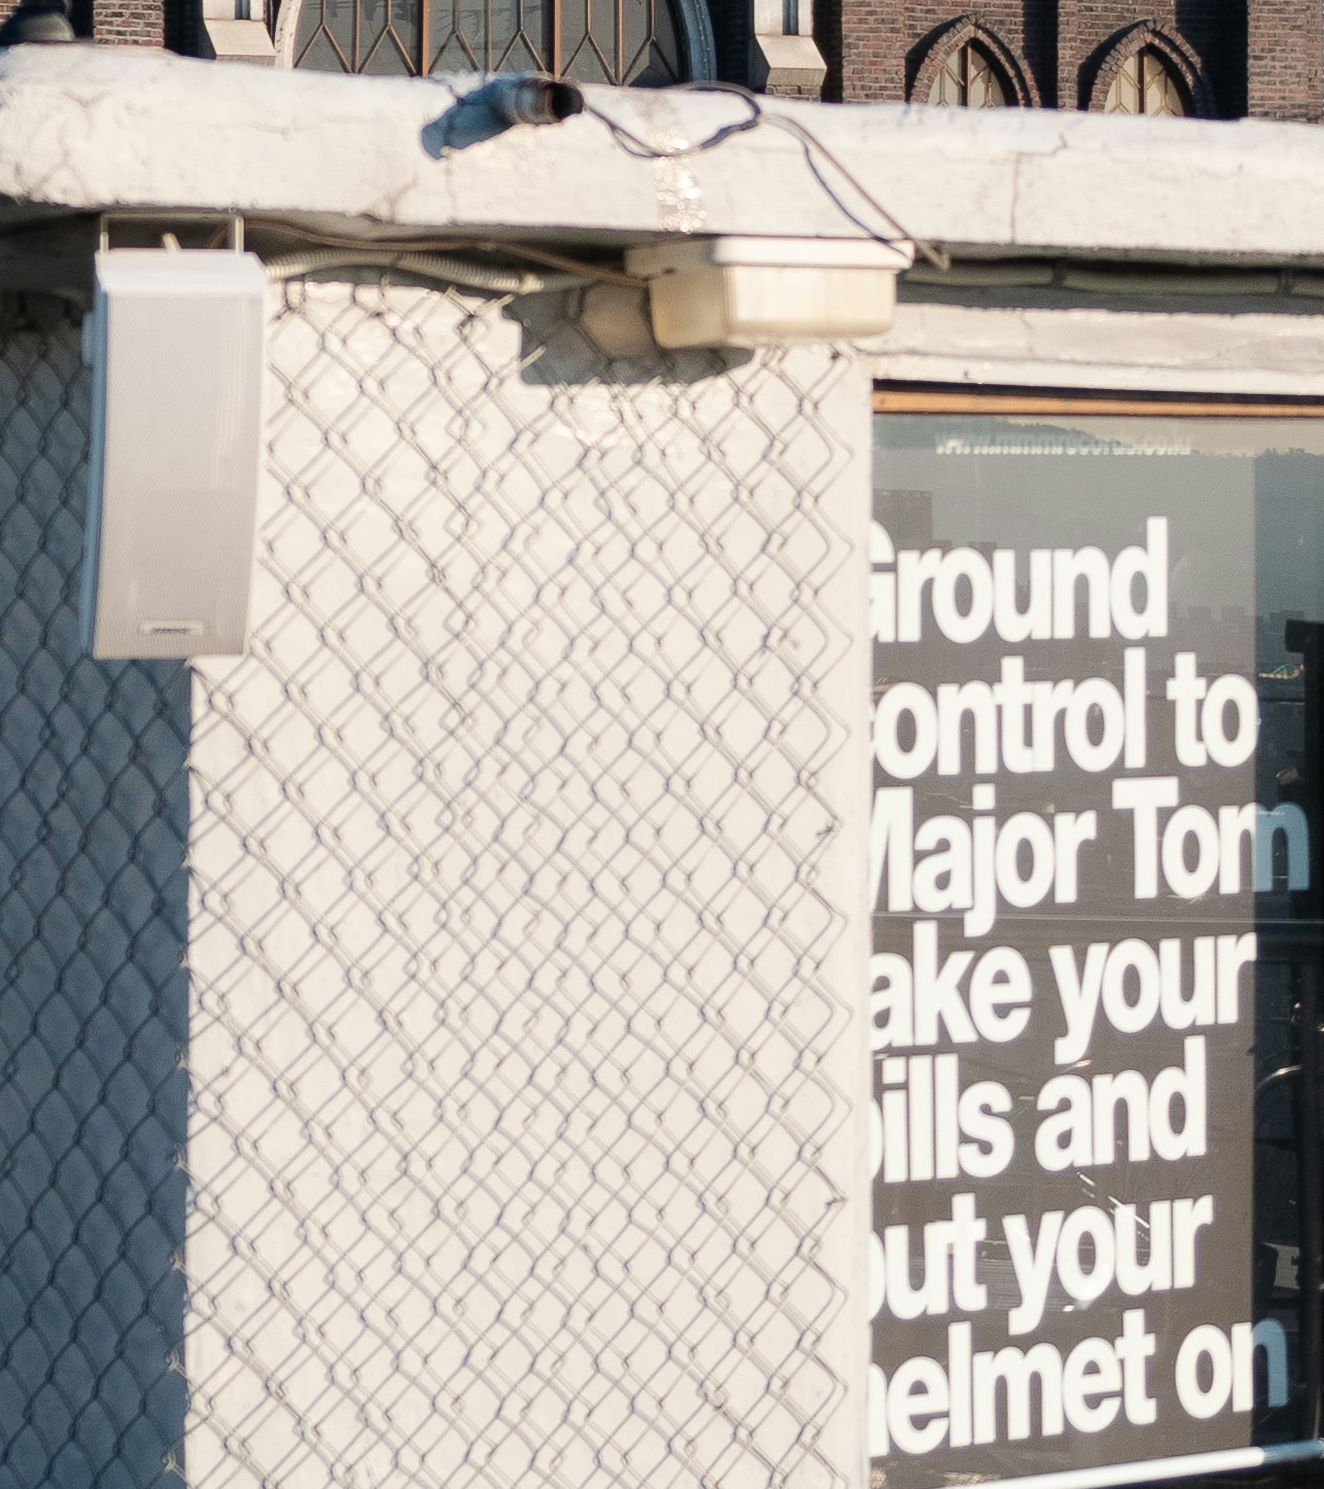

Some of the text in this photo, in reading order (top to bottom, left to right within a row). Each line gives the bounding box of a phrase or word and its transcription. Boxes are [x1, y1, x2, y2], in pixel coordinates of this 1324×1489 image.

[870, 646, 1259, 779] ontrol to
[1112, 776, 1310, 899] Tom
[870, 920, 1257, 1065] ake your
[870, 1035, 1206, 1184] ills and
[870, 1193, 1213, 1334] ut your
[1176, 1317, 1289, 1419] on
